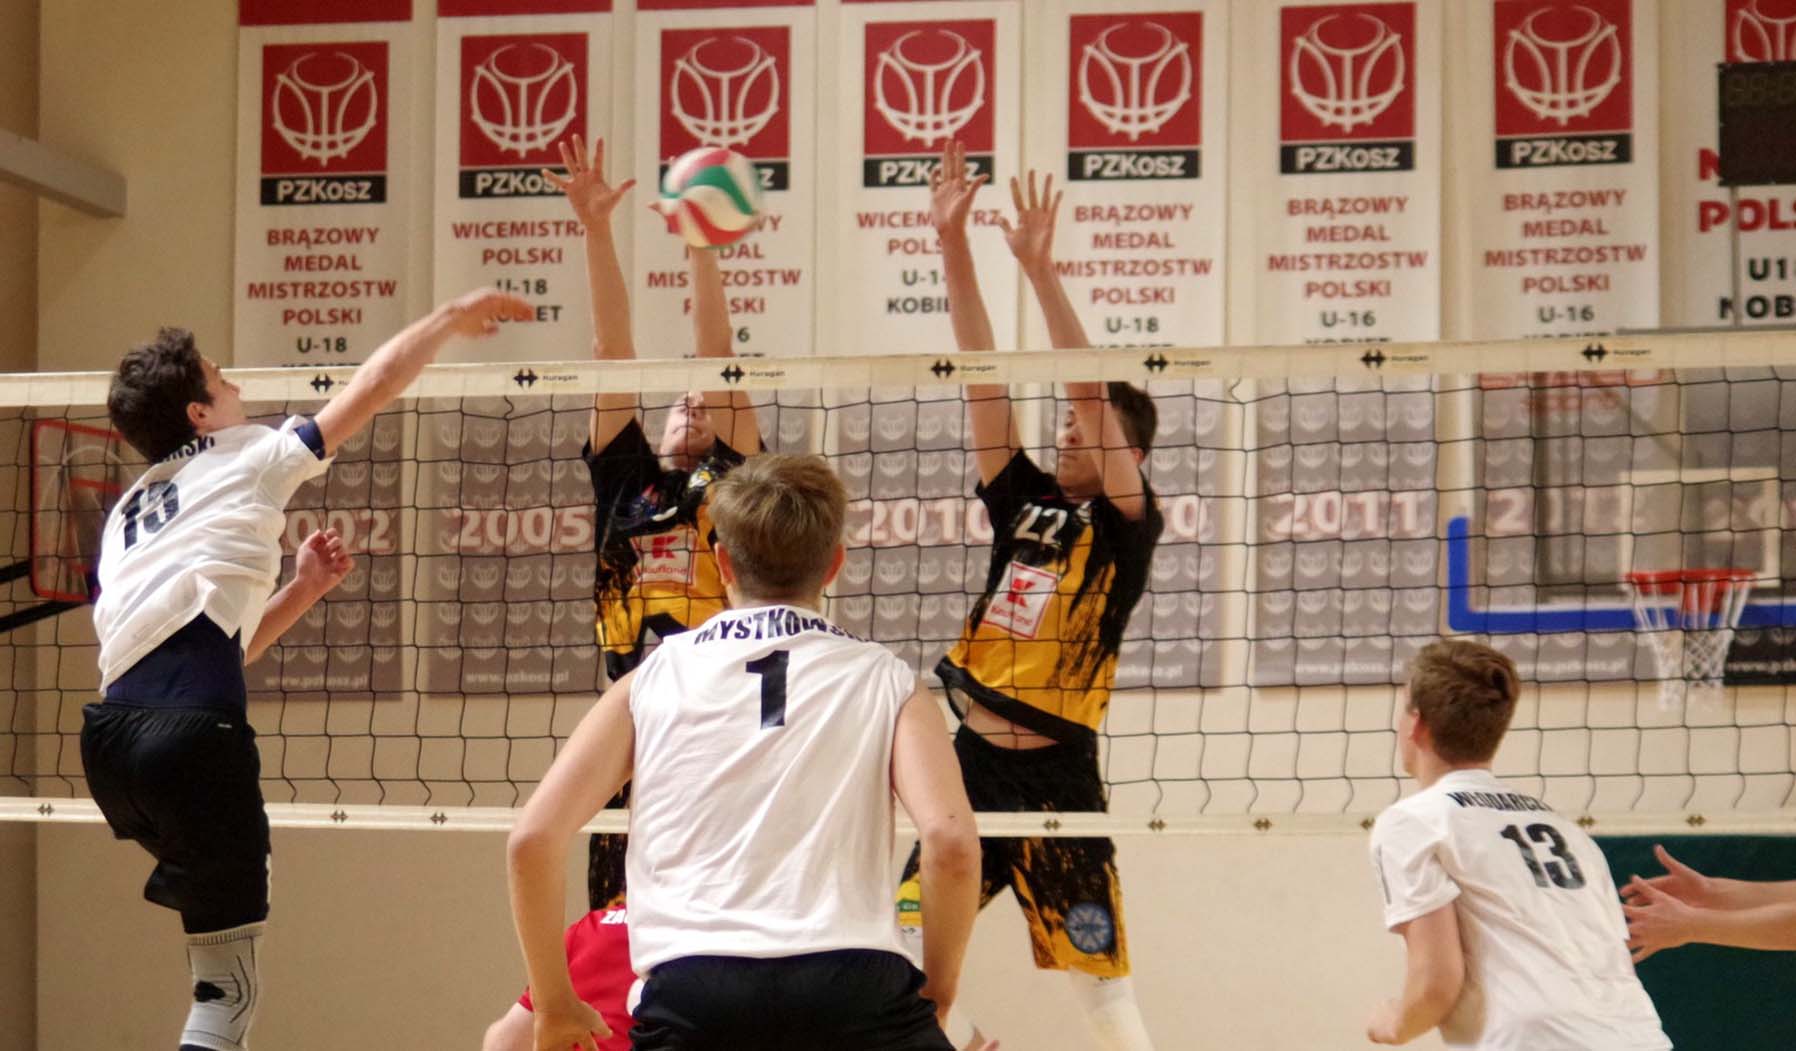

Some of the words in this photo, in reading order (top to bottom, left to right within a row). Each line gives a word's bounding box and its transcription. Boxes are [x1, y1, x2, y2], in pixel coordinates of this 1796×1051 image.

[1287, 196, 1409, 219] BRĄZOWY
[1504, 189, 1627, 214] BRĄZOWY
[1075, 203, 1195, 226] BRĄZOWY
[266, 227, 380, 249] BRĄZOWY
[452, 221, 585, 239] WICEMISTR
[1306, 225, 1391, 243] MEDAL
[1523, 219, 1610, 238] MEDAL
[1092, 232, 1176, 249] MEDAL
[284, 255, 363, 272] MEDAL
[482, 248, 563, 266] POLSKI
[1268, 252, 1428, 271] MISTRZOSTW
[1485, 245, 1647, 268] MISTRZOSTW
[1056, 259, 1213, 278] MISTRZOSTW
[648, 269, 801, 288] MISZOSTW
[1522, 273, 1611, 294] POLSKI
[248, 280, 397, 300] MISTRZOSTW
[1091, 287, 1176, 304] POLSKI
[1305, 280, 1392, 299] POLSKI
[282, 309, 363, 326] POLSKI
[1321, 310, 1376, 329] U-16
[1538, 305, 1595, 324] U-16
[1106, 317, 1160, 334] U-18
[297, 337, 348, 354] U-18
[1273, 491, 1422, 536] 2011
[451, 505, 594, 548] 2005
[745, 649, 790, 730] 1
[1499, 823, 1586, 889] 13
